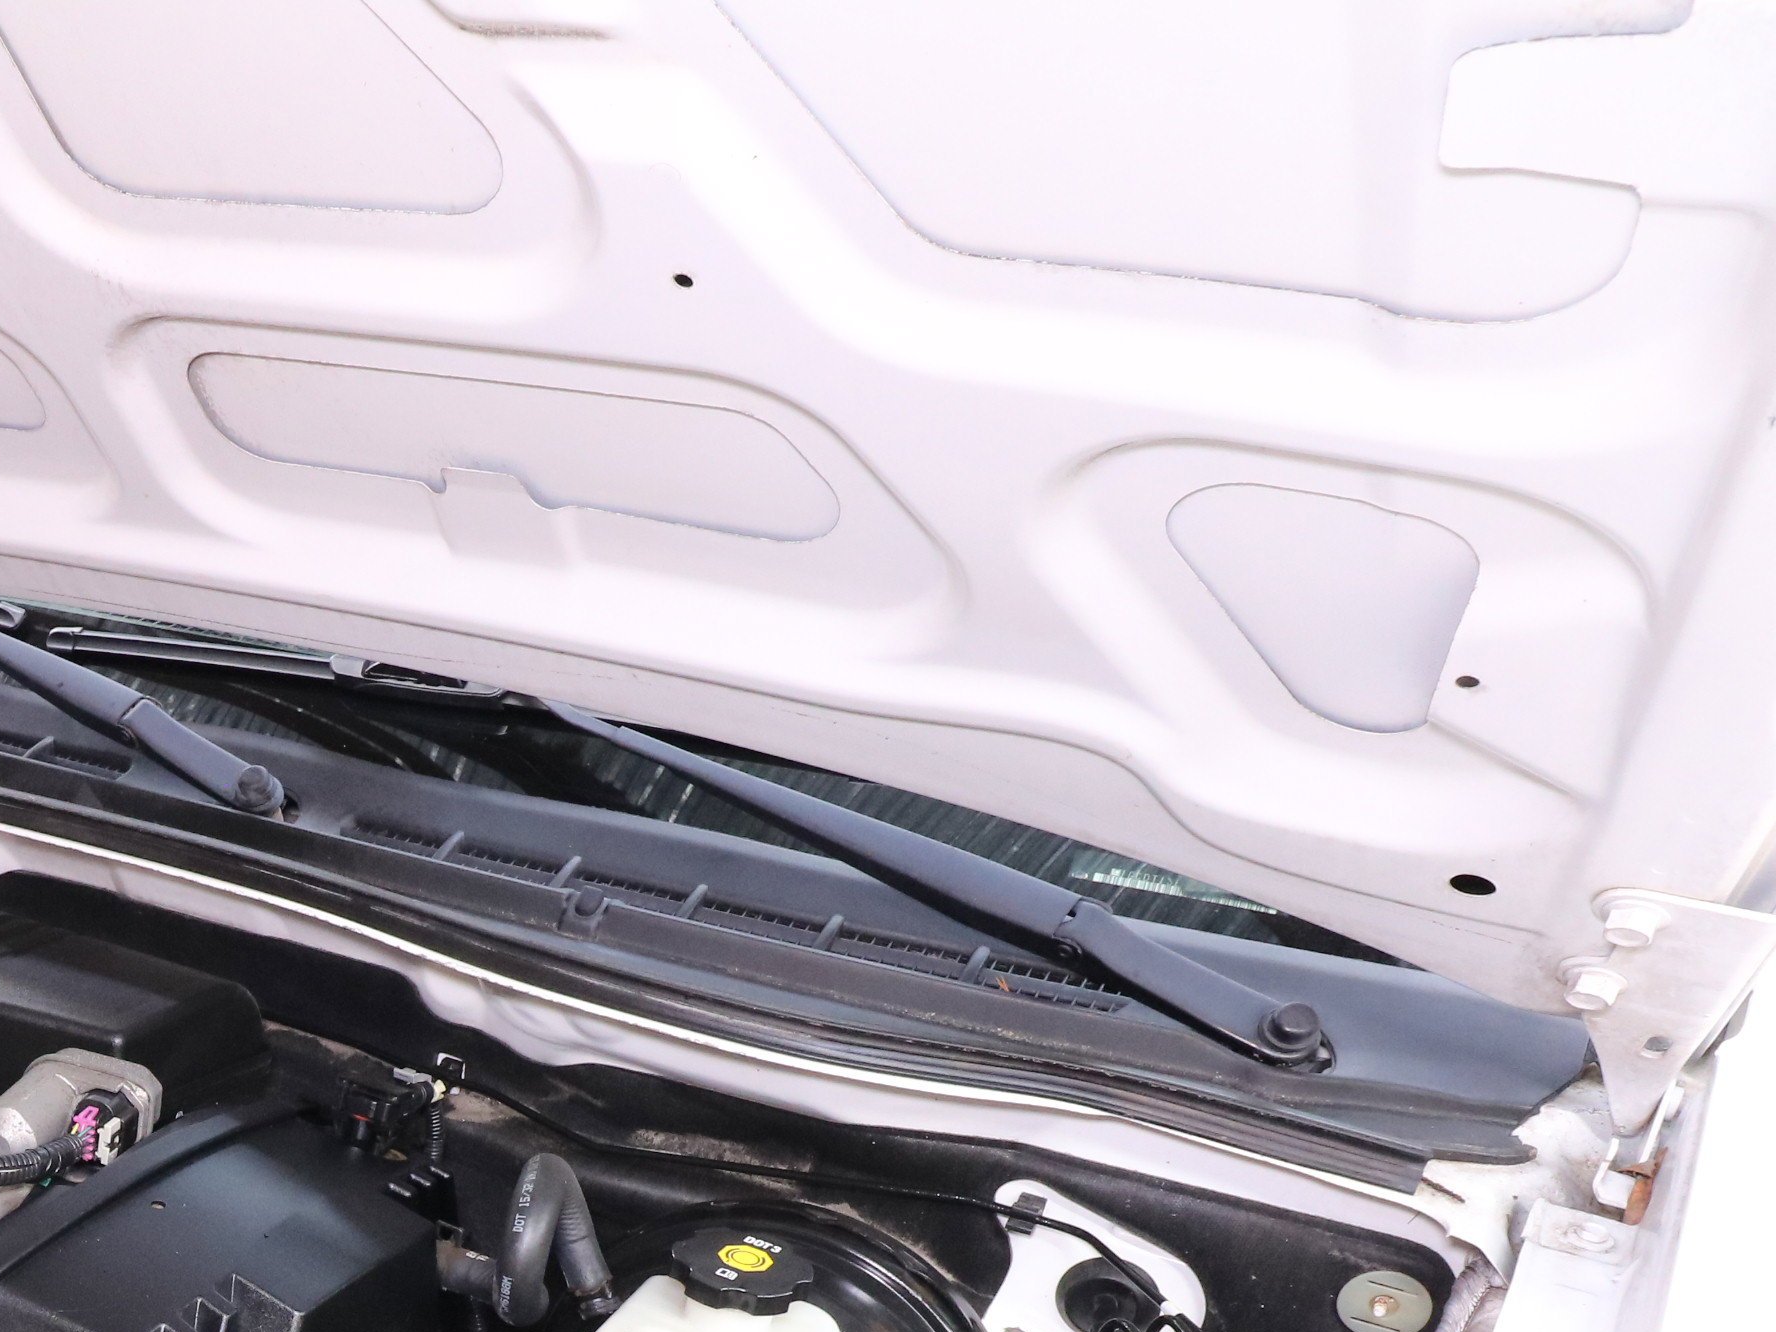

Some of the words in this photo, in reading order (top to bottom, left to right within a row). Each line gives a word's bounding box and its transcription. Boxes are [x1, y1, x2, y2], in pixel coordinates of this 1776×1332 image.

[512, 1213, 527, 1232] DOT
[743, 1235, 770, 1250] DOT
[769, 1243, 782, 1253] 3
